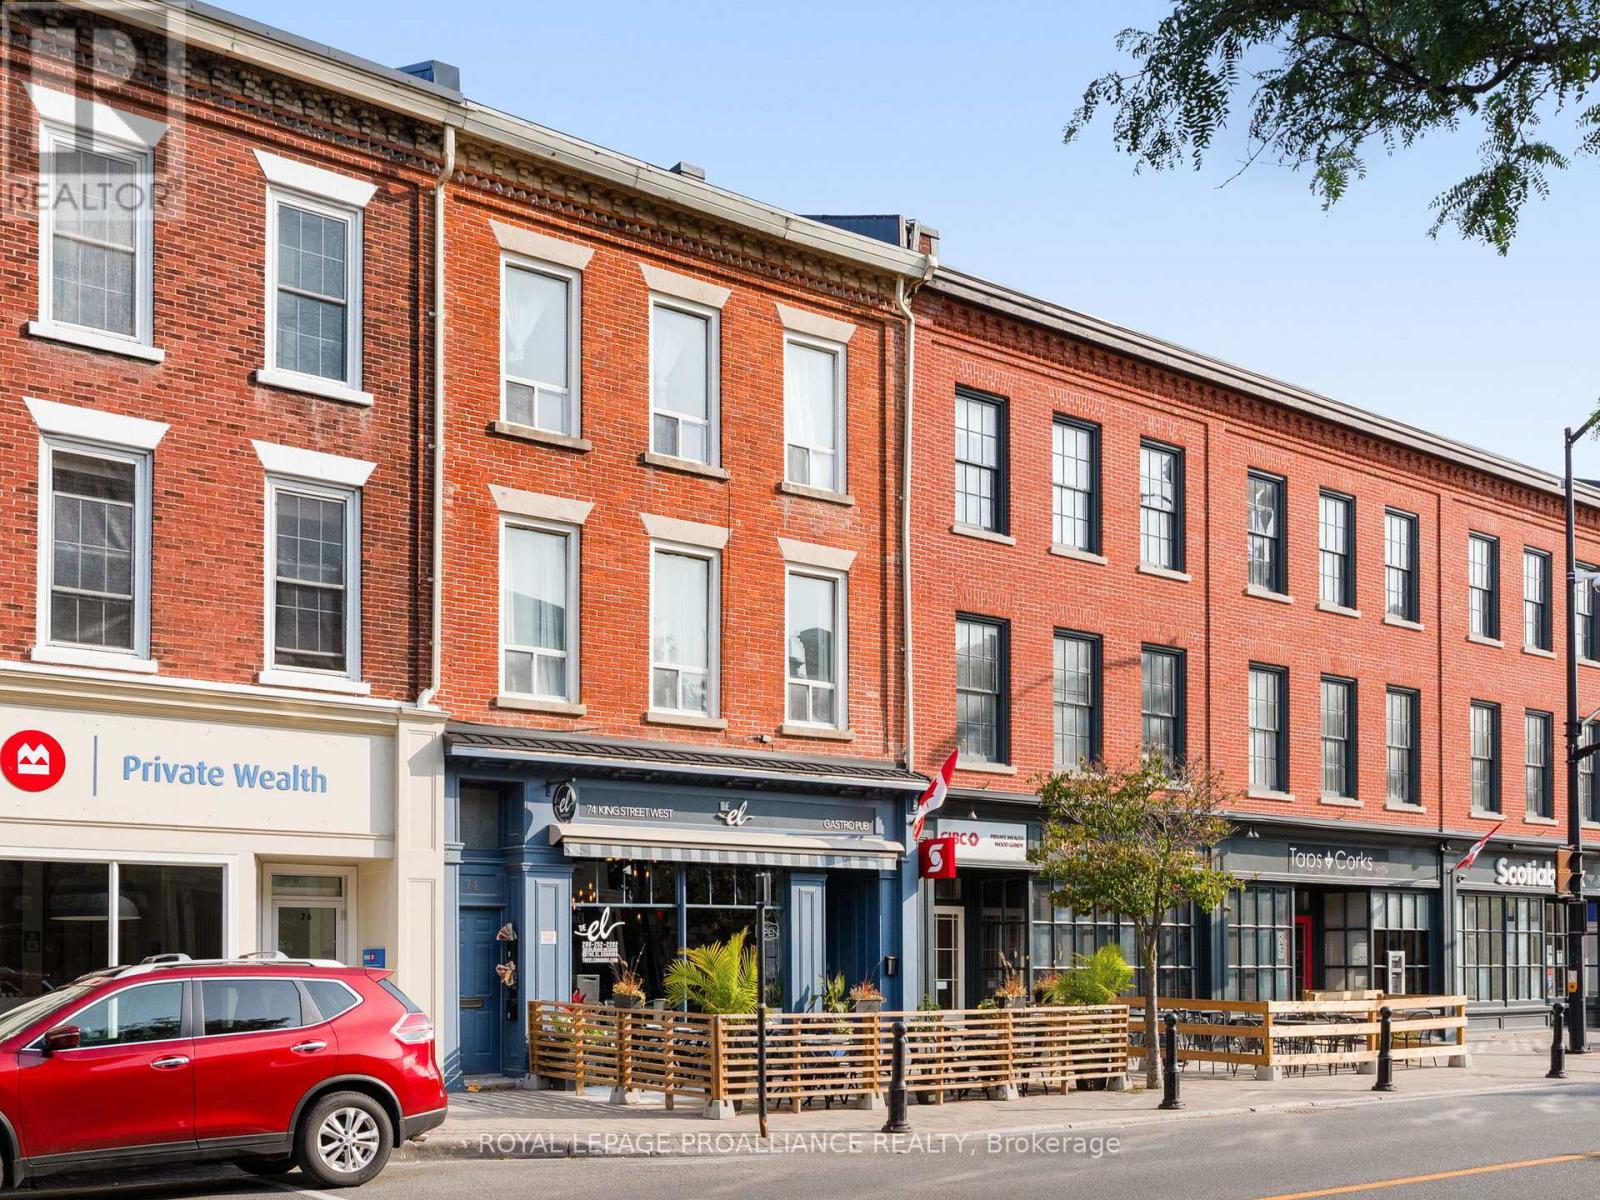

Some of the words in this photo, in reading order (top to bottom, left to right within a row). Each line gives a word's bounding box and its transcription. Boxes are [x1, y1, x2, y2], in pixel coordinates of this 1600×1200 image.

[123, 755, 225, 787] Private
[233, 763, 328, 793] Wealth
[587, 804, 596, 815] 74
[599, 805, 620, 816] KING
[620, 806, 650, 818] STREET
[650, 808, 673, 819] WEST
[717, 800, 755, 826] el
[823, 819, 855, 830] GASTRO
[855, 821, 870, 831] PUB
[1289, 847, 1322, 869] Taps
[1334, 850, 1373, 871] Corks
[300, 912, 312, 921] 76
[573, 906, 625, 942] el
